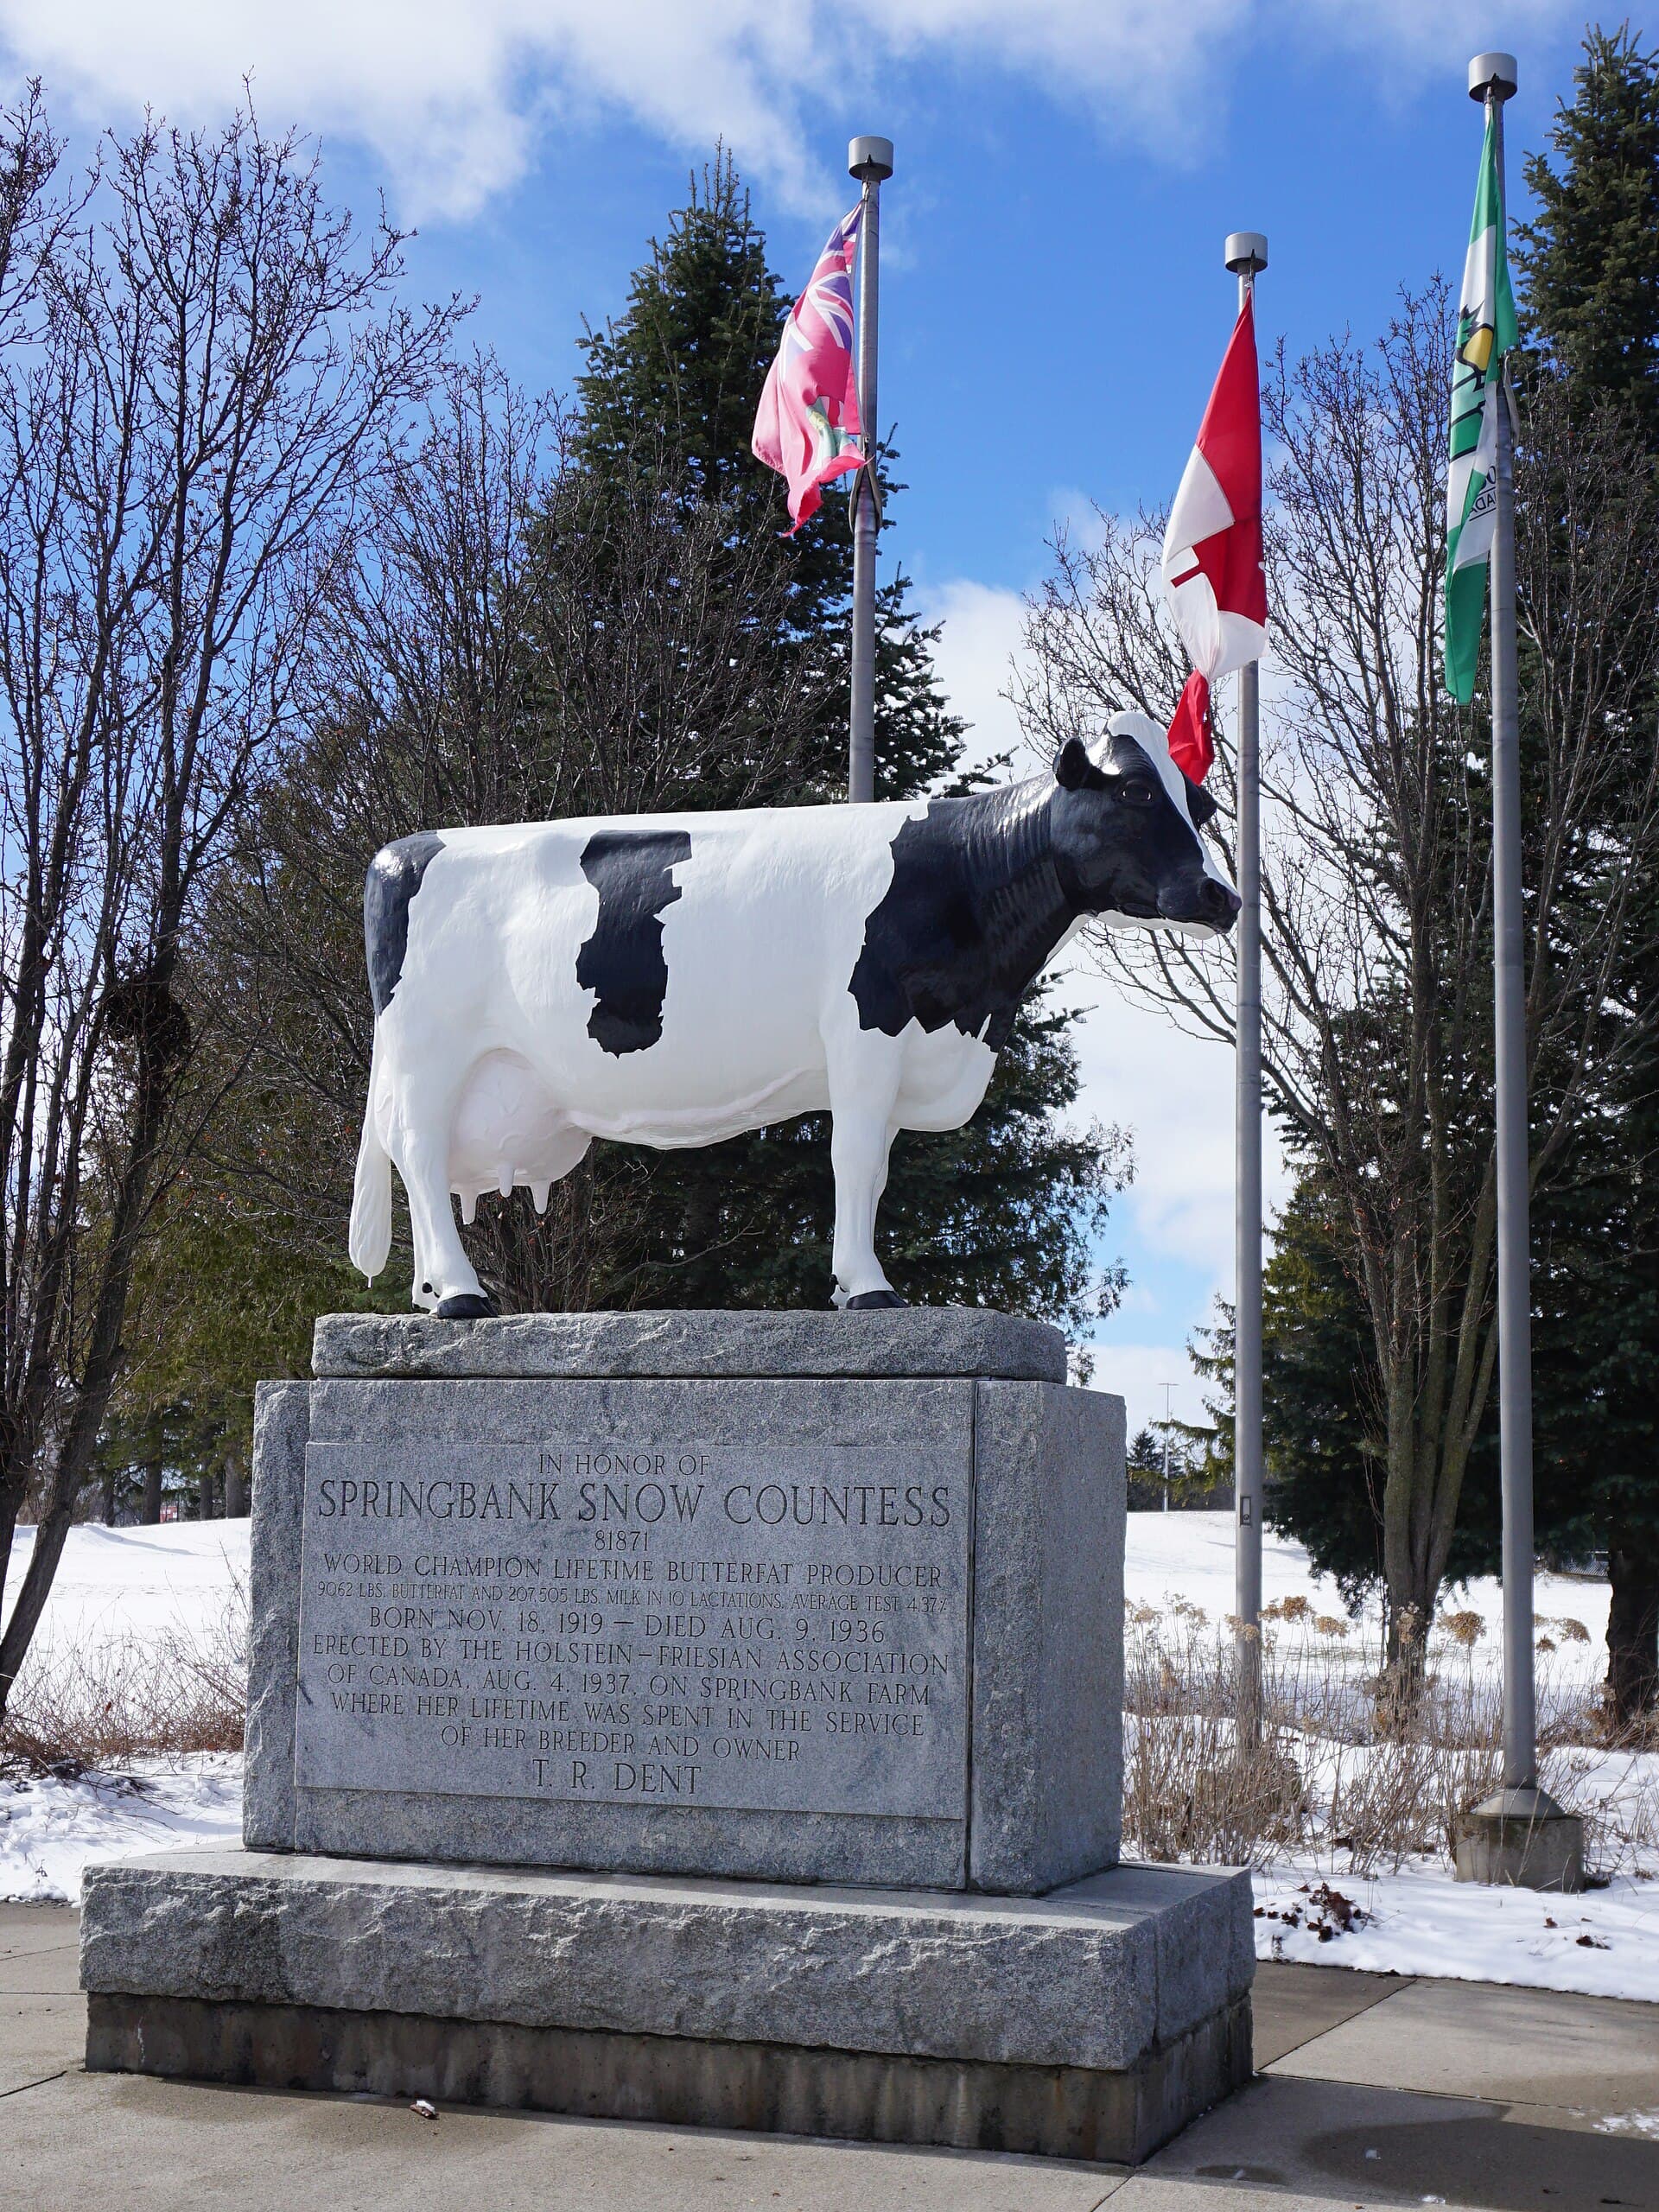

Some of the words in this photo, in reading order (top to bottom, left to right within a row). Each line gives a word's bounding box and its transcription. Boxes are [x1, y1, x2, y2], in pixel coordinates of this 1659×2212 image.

[538, 1454, 562, 1473] IN
[575, 1454, 665, 1475] HONOR
[678, 1455, 709, 1476] OF
[318, 1479, 561, 1521] SPRINGBANK
[578, 1483, 704, 1523] SNOW
[724, 1484, 950, 1528] COUNTESS
[594, 1530, 648, 1551] 81871
[324, 1554, 402, 1576] WORLD
[414, 1555, 541, 1579] CHAMPION
[552, 1558, 654, 1582] LIFETIME
[667, 1561, 794, 1585] BUTTERFAT
[807, 1564, 943, 1588] PRODUCER
[317, 1580, 353, 1597] 9062
[359, 1582, 386, 1598] LBS.
[392, 1583, 464, 1600] BUTTERFAT
[472, 1586, 503, 1601] AND
[575, 1587, 601, 1605] LBS.
[607, 1588, 640, 1605] MILK
[646, 1590, 662, 1606] IN
[791, 1593, 858, 1611] AVERAGE
[866, 1595, 899, 1612] TEST
[370, 1606, 434, 1630] BORN
[448, 1608, 505, 1633] NOV.
[518, 1611, 545, 1635] 18,
[558, 1612, 603, 1635] 1919
[645, 1614, 706, 1637] DIED
[721, 1617, 781, 1640] AUG.
[831, 1619, 885, 1643] 1936
[314, 1634, 409, 1656] ERECTED
[421, 1637, 447, 1658] BY
[460, 1639, 502, 1661] THE
[775, 1649, 950, 1675] ASSOCIATION
[327, 1663, 357, 1685] OF
[369, 1665, 470, 1689] CANADA,
[482, 1669, 537, 1692] AUG.
[650, 1675, 687, 1697] ON
[700, 1677, 854, 1703] SPRINGBANK
[868, 1681, 931, 1706] FARM
[331, 1692, 404, 1715] WHERE
[416, 1695, 459, 1717] HER
[471, 1697, 569, 1721] LIFETIME
[584, 1701, 631, 1725] WAS
[643, 1704, 715, 1728] SPENT
[727, 1707, 752, 1729] IN
[766, 1708, 812, 1732] THE
[826, 1711, 925, 1736] SERVICE
[441, 1725, 471, 1746] OF
[484, 1727, 526, 1750] HER
[538, 1729, 635, 1754] BREEDER
[648, 1735, 700, 1758] AND
[713, 1737, 800, 1761] OWNER
[532, 1758, 553, 1788] T.
[571, 1760, 595, 1790] R.
[613, 1762, 702, 1796] DENT
